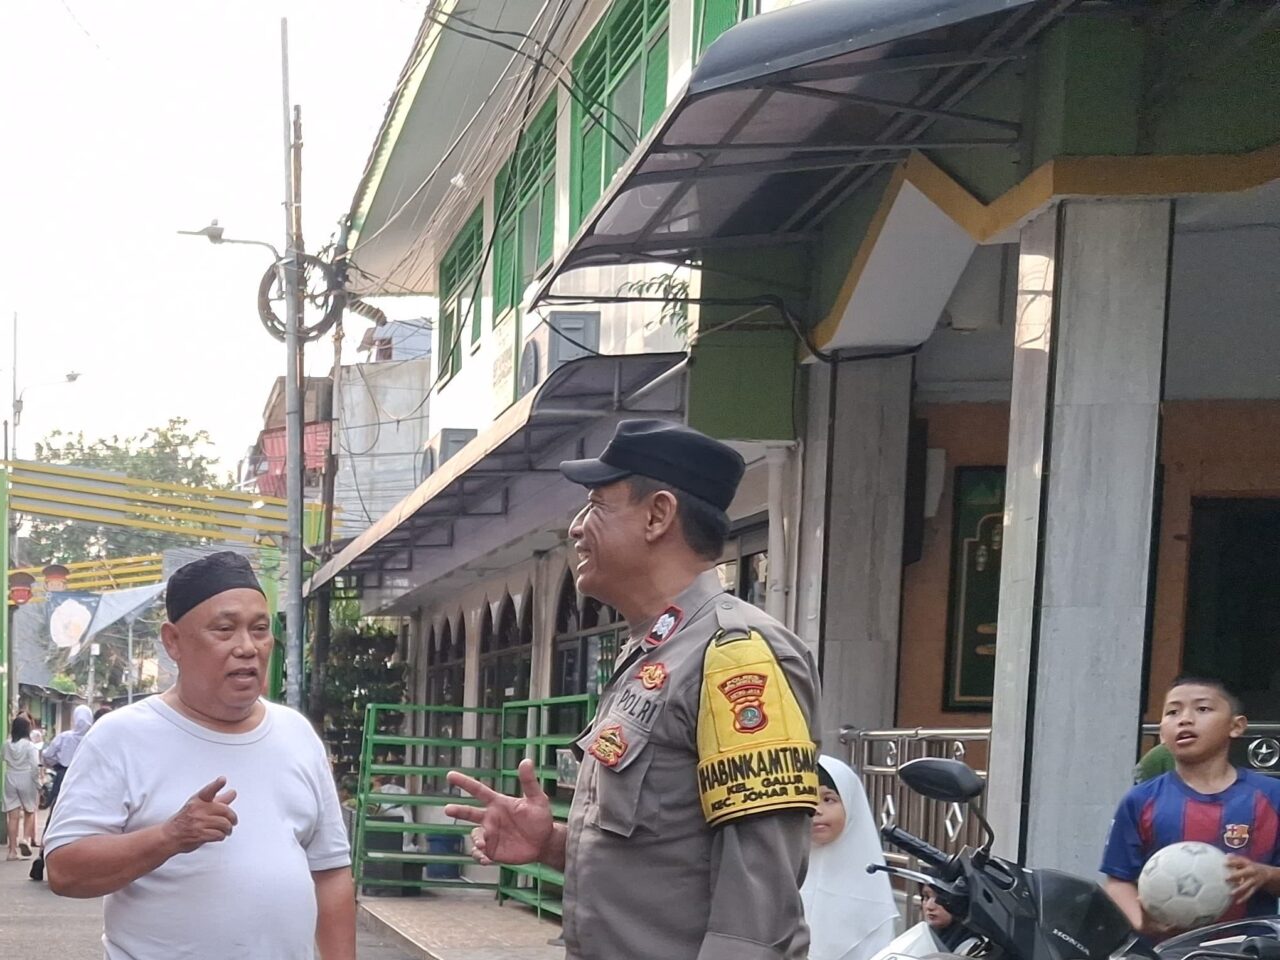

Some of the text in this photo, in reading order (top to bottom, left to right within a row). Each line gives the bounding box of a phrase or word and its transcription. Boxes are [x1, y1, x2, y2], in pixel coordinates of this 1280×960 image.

[617, 689, 658, 724] POLRI
[726, 774, 805, 796] KEL. GALUR
[711, 797, 736, 813] KEC.
[740, 786, 789, 804] JOHAR
[1052, 928, 1090, 956] HONDA
